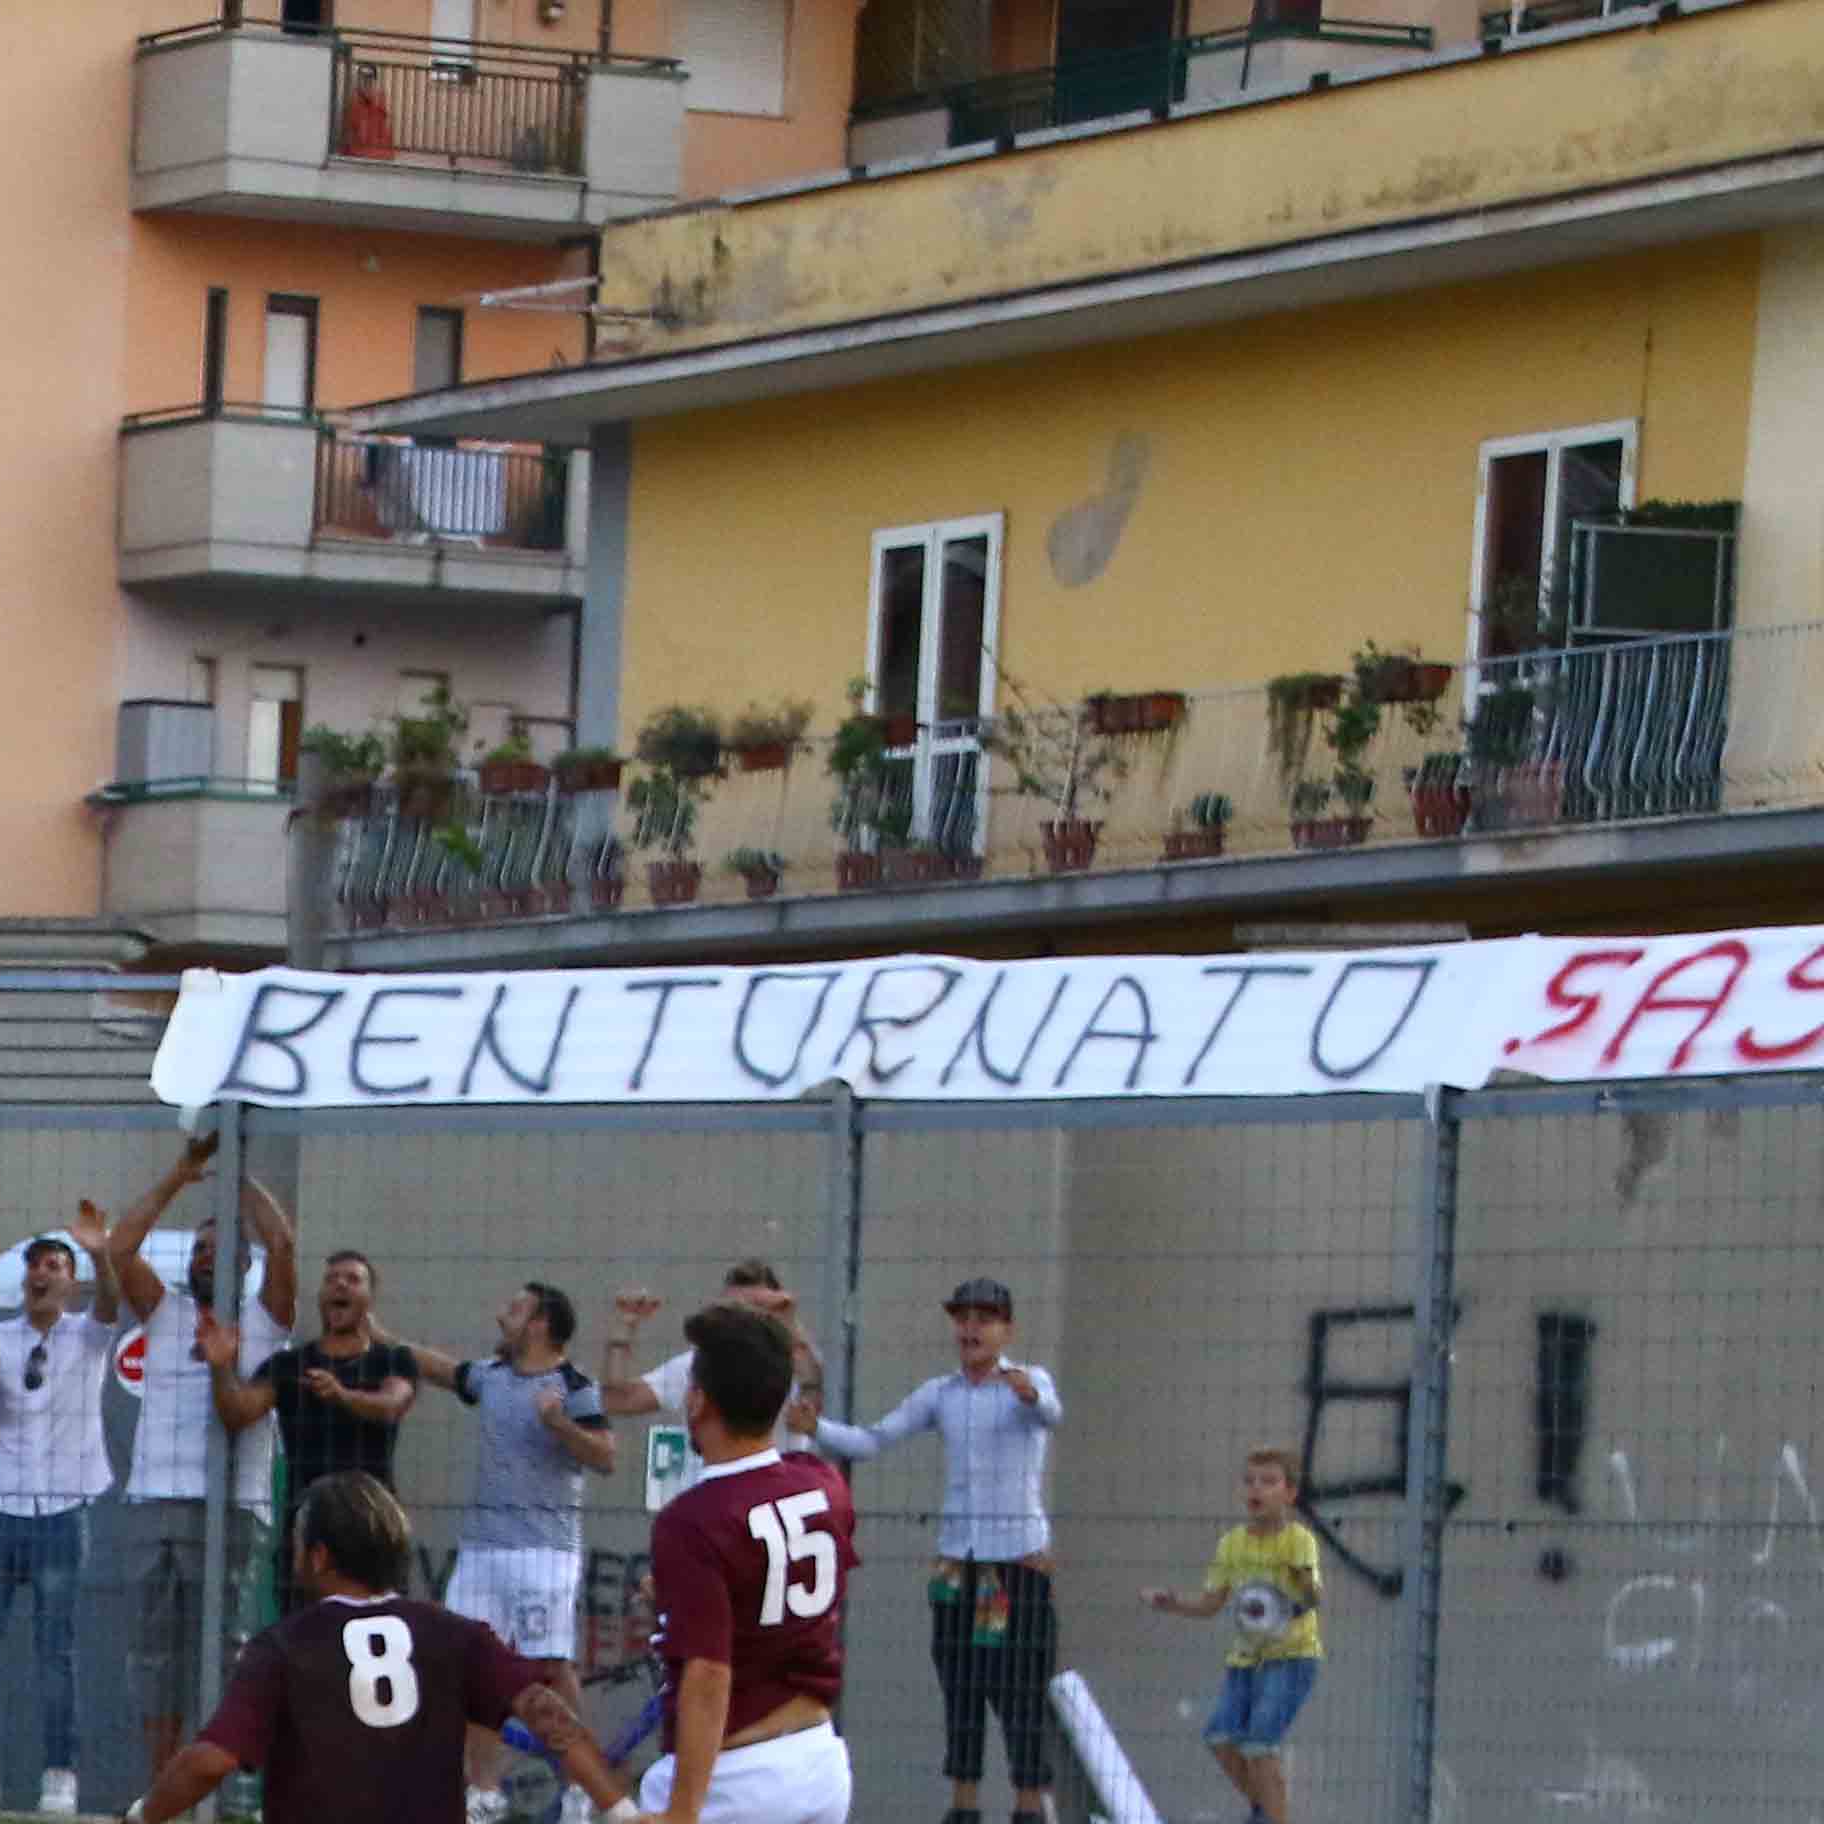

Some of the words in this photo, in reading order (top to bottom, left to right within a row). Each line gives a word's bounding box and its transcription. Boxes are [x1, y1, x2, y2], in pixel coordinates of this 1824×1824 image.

[217, 958, 1440, 1097] BENTORNATO
[748, 1489, 838, 1626] 15
[342, 1615, 420, 1728] 8
